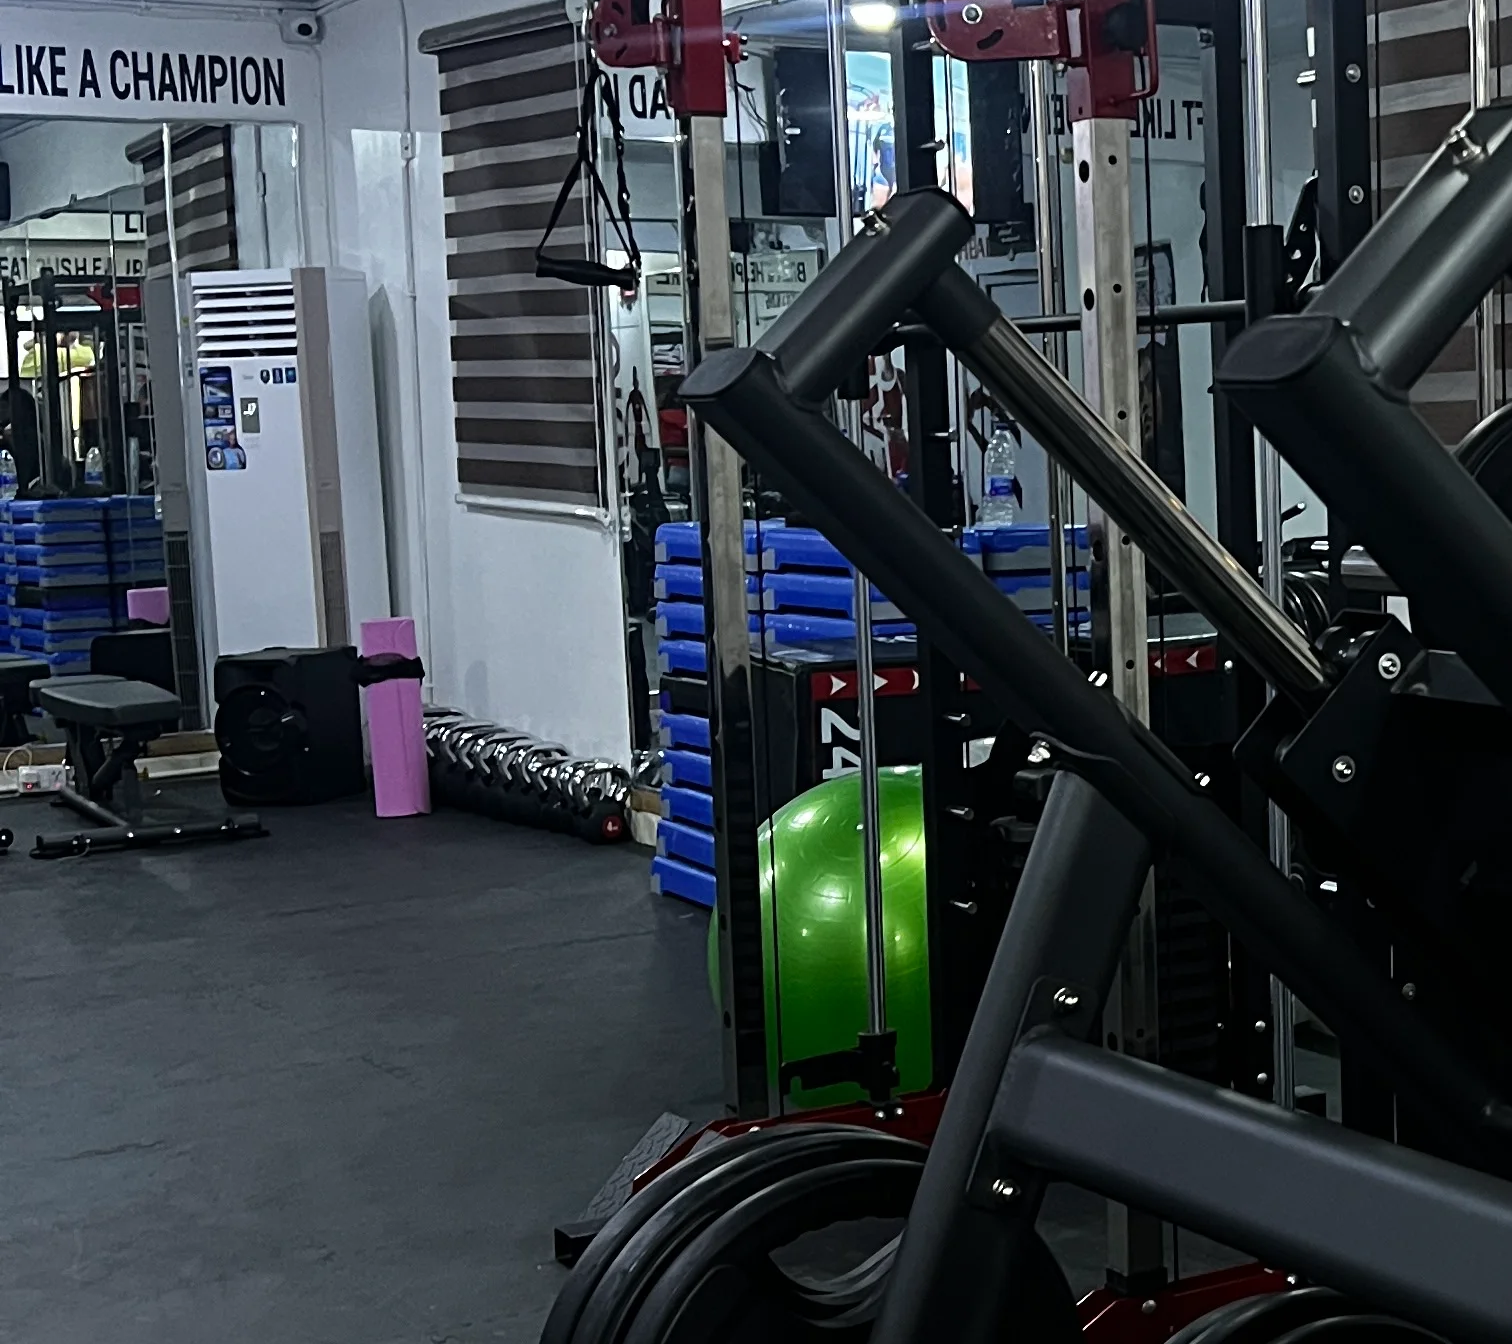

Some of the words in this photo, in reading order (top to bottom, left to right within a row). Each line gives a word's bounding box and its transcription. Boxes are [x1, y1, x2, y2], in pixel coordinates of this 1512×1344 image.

[0, 44, 68, 97] LIKE
[79, 49, 101, 98] A
[110, 49, 286, 106] CHAMPION
